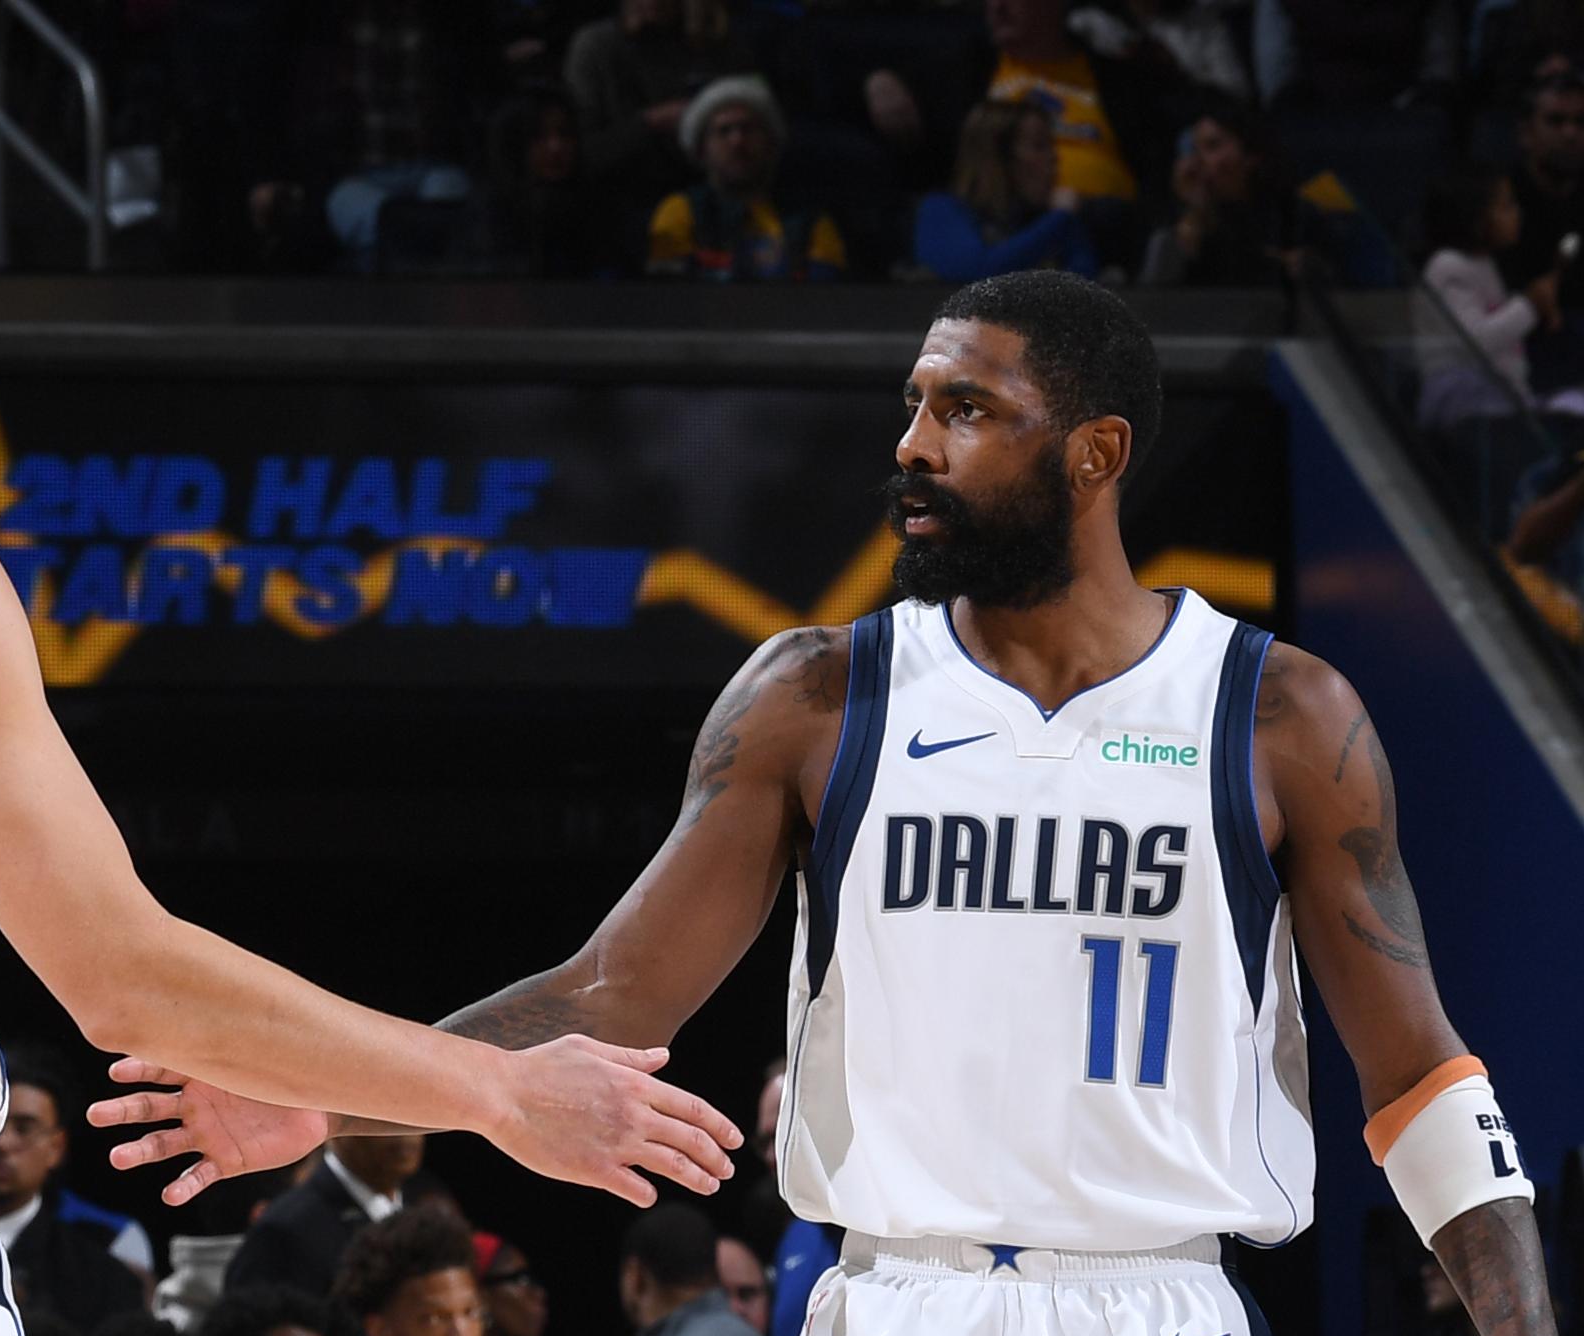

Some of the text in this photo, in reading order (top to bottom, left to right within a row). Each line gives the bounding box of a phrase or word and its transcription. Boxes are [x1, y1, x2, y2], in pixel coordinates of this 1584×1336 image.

[248, 455, 555, 541] HALF
[0, 543, 652, 630] TARTS NOW
[1100, 731, 1201, 767] chime
[880, 812, 1191, 920] DALLAS
[1080, 933, 1182, 1091] 11
